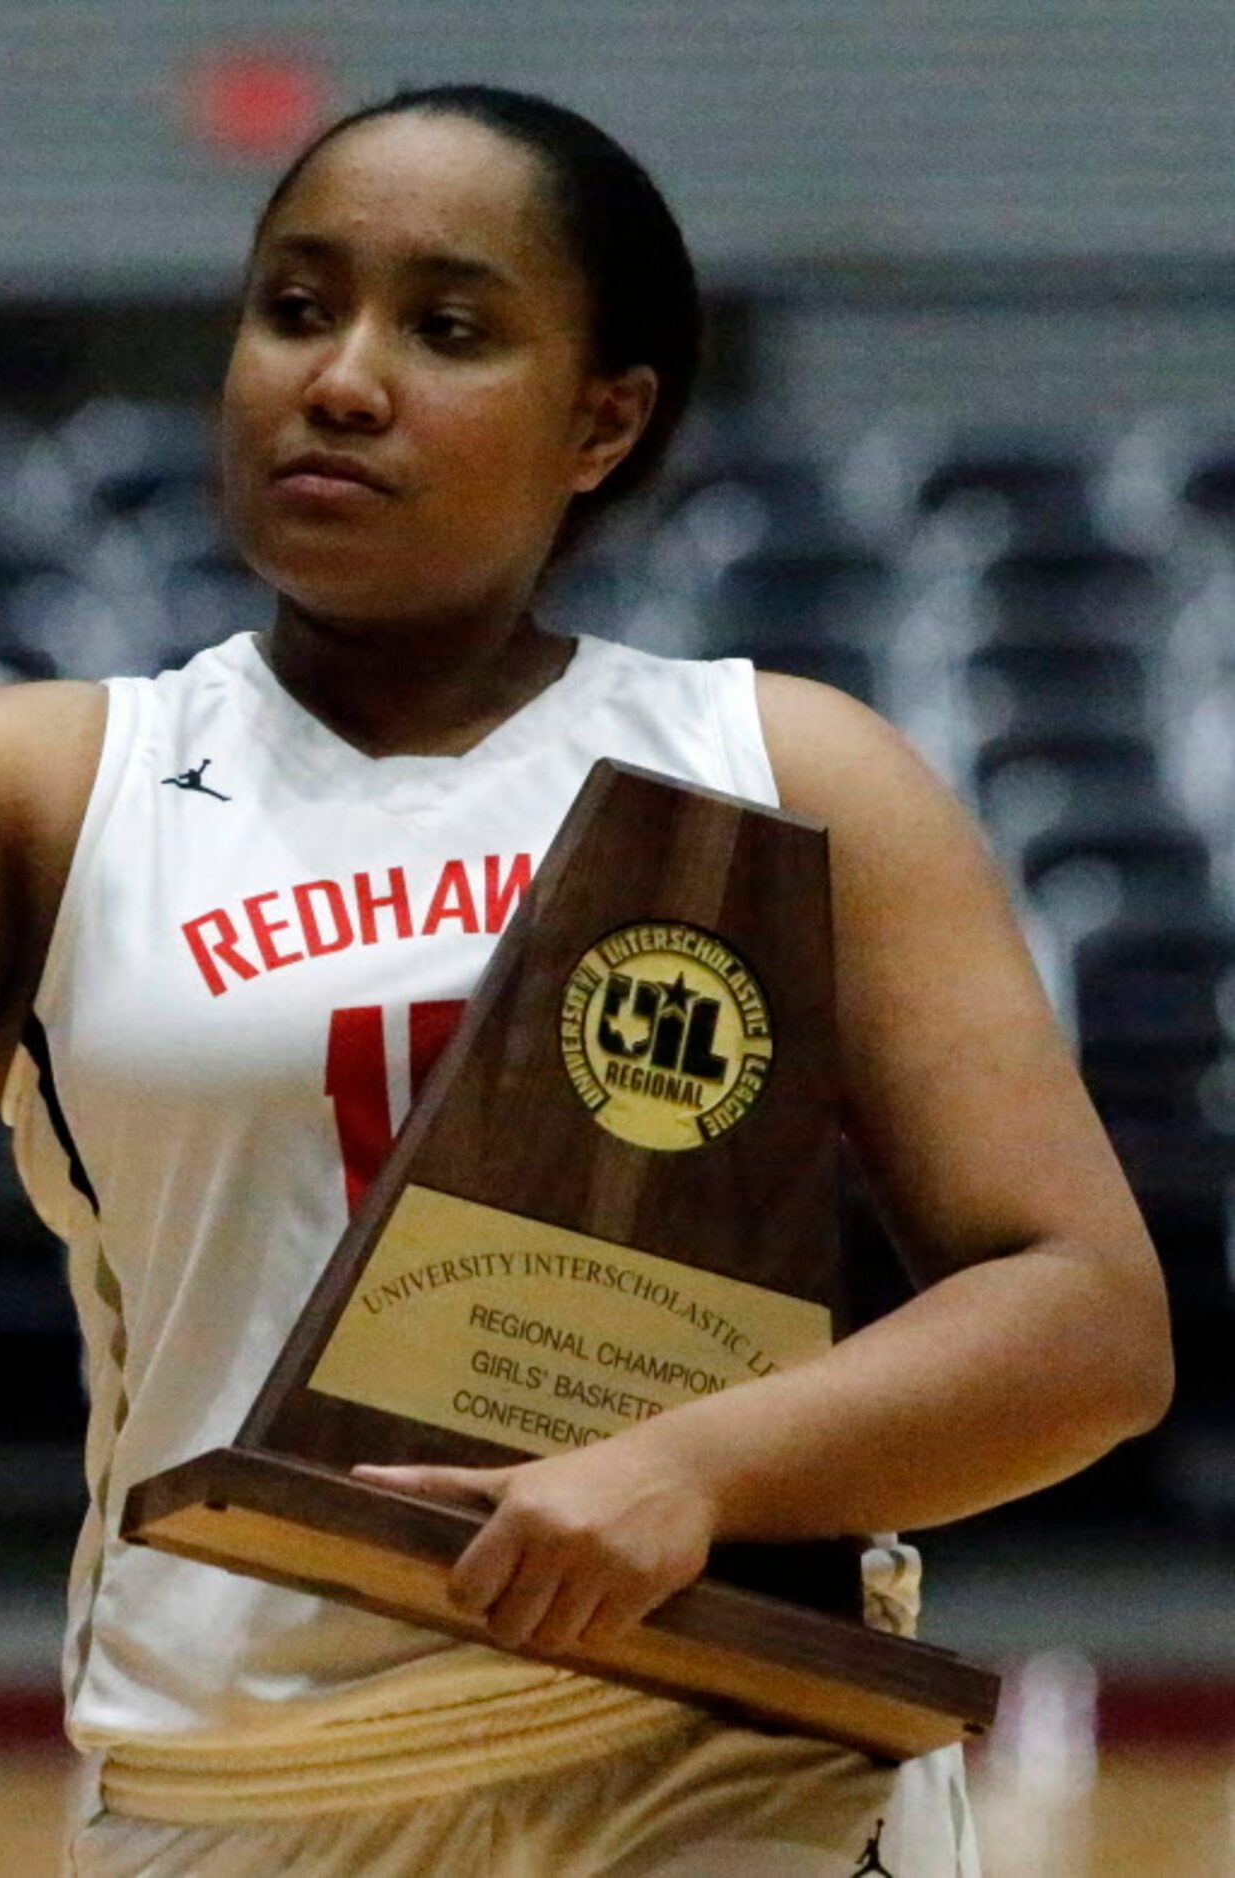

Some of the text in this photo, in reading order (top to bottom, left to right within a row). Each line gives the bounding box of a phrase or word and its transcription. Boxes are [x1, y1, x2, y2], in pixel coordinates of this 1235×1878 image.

[562, 925, 771, 1142] UNIVERSITY INTERSCHOLASTIC LEAGUE
[597, 969, 729, 1086] UIL
[604, 1060, 706, 1108] REGIONAL
[361, 1252, 516, 1315] UNIVERSITY
[522, 1252, 752, 1356] INTERSCHOLASTIC
[469, 1303, 591, 1361] REGIONAL
[470, 1349, 549, 1390] GIRLS'
[452, 1389, 616, 1448] CONFERENC
